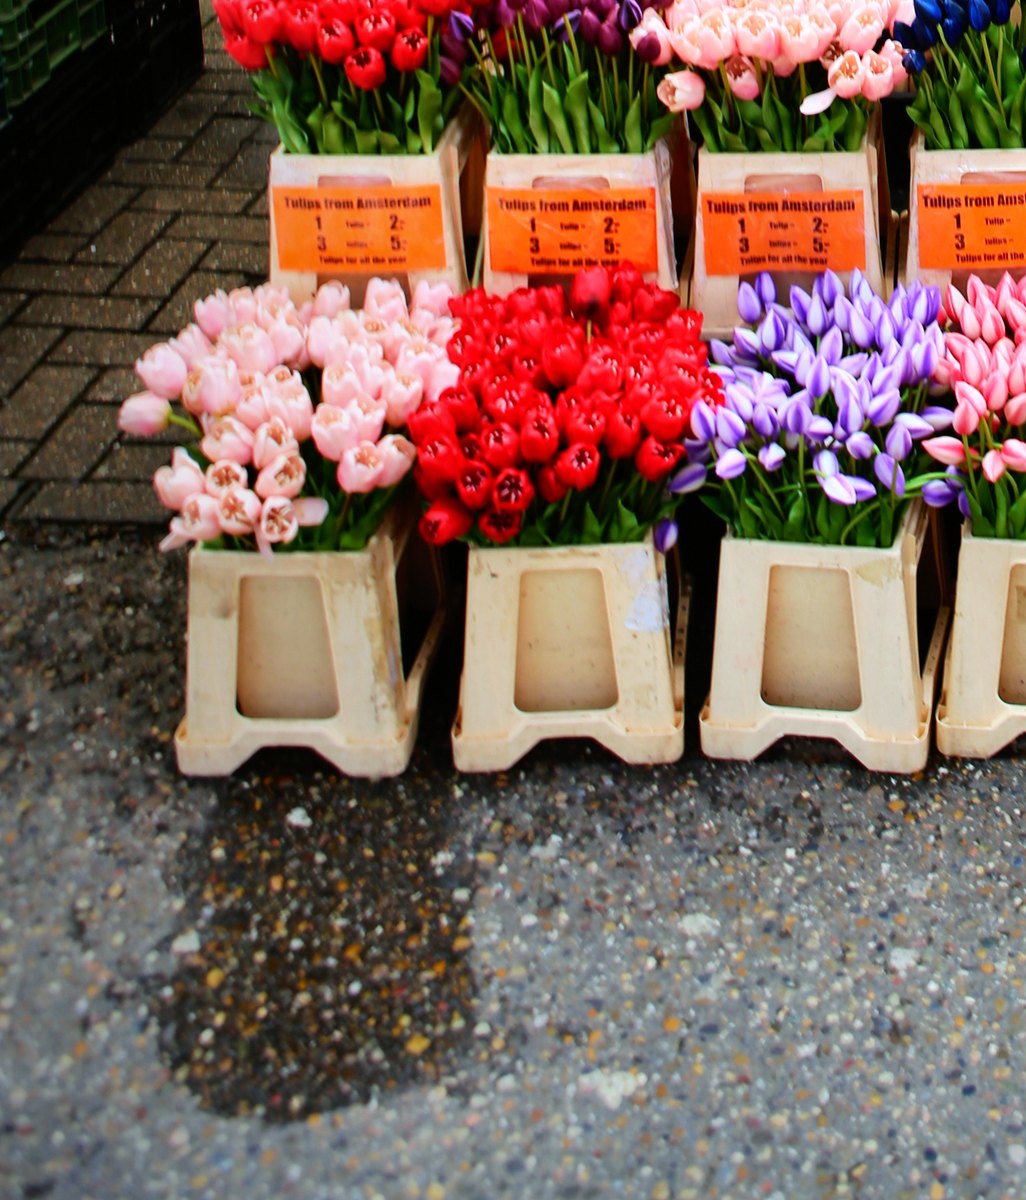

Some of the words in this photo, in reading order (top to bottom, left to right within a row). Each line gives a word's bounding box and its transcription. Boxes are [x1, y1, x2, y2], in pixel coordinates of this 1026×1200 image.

[284, 196, 321, 210] Tulips
[324, 197, 353, 209] from
[357, 195, 431, 209] Amsterdam
[499, 198, 536, 212] Tulips
[539, 199, 569, 212] from
[572, 199, 647, 212] Amsterdam
[707, 200, 746, 214] Tulips
[748, 199, 778, 212] from
[781, 198, 856, 212] Amsterdam
[923, 195, 962, 209] Tulips
[964, 195, 994, 207] from
[315, 215, 322, 230] 1
[530, 217, 536, 233] 1
[738, 218, 746, 233] 1
[769, 222, 788, 230] Tulip
[953, 213, 962, 229] 1
[985, 217, 1004, 226] Tulip
[317, 236, 327, 251] 3
[529, 238, 540, 254] 3
[738, 237, 750, 253] 3
[954, 234, 965, 250] 3
[319, 256, 344, 265] Tulips
[372, 256, 386, 264] the
[388, 256, 406, 265] year
[531, 258, 556, 267] Tulips
[558, 257, 570, 266] for
[572, 257, 583, 266] all
[585, 257, 599, 266] the
[601, 258, 619, 266] year
[740, 257, 766, 266] Tulips
[768, 256, 780, 264] for
[782, 256, 793, 264] all
[794, 255, 808, 263] the
[809, 257, 828, 266] year
[956, 253, 982, 263] Tulips
[984, 253, 995, 262] for
[999, 252, 1009, 261] all
[1010, 251, 1024, 261] the
